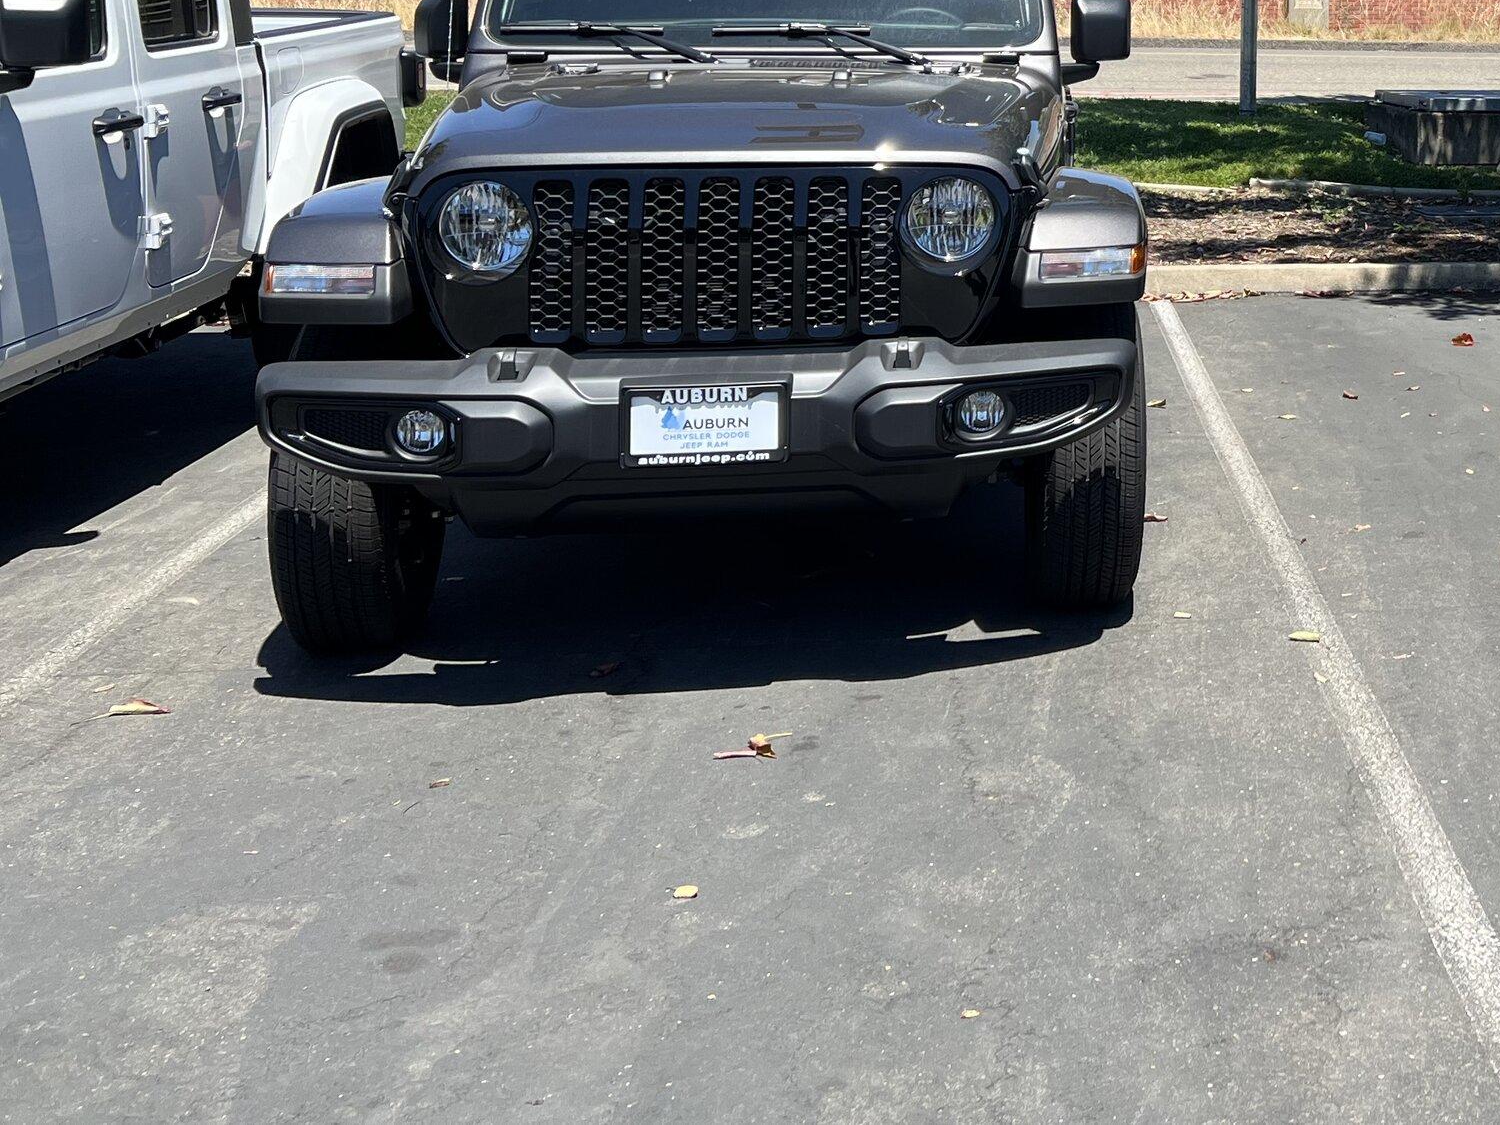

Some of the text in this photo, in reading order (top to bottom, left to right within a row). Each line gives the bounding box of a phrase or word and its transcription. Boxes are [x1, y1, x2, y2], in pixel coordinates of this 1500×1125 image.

[661, 387, 748, 405] AUBURN
[682, 417, 749, 430] AUBURN
[662, 431, 750, 441] CHRYSLER DODGE
[680, 441, 729, 450] JEEP RAM
[637, 451, 770, 465] auburnjeep.com
